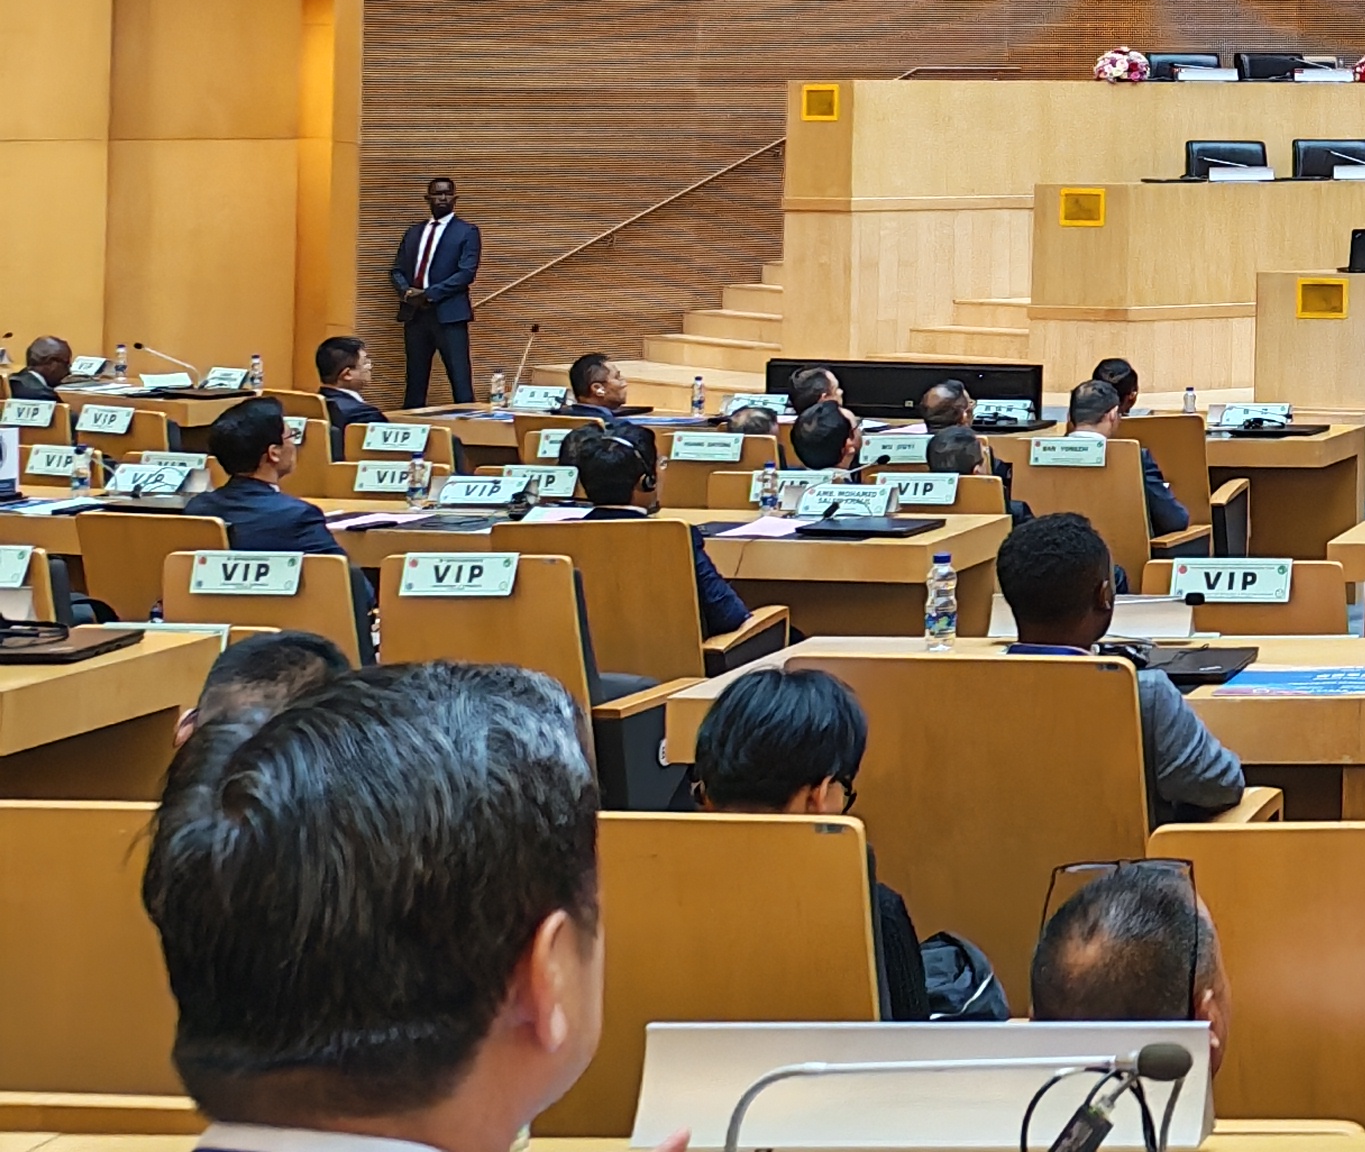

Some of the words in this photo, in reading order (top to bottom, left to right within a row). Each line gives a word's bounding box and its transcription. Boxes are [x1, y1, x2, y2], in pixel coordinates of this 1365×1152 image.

[17, 407, 39, 418] VIP
[93, 413, 117, 424] VIP
[382, 431, 411, 443] VIP
[45, 454, 72, 467] VIP
[132, 472, 165, 484] VIP
[377, 471, 409, 484] VIP
[465, 485, 501, 497] VIP
[899, 482, 934, 496] VIP
[221, 562, 271, 583] VIP
[433, 564, 484, 584] VIP
[1204, 571, 1257, 591] VIP
